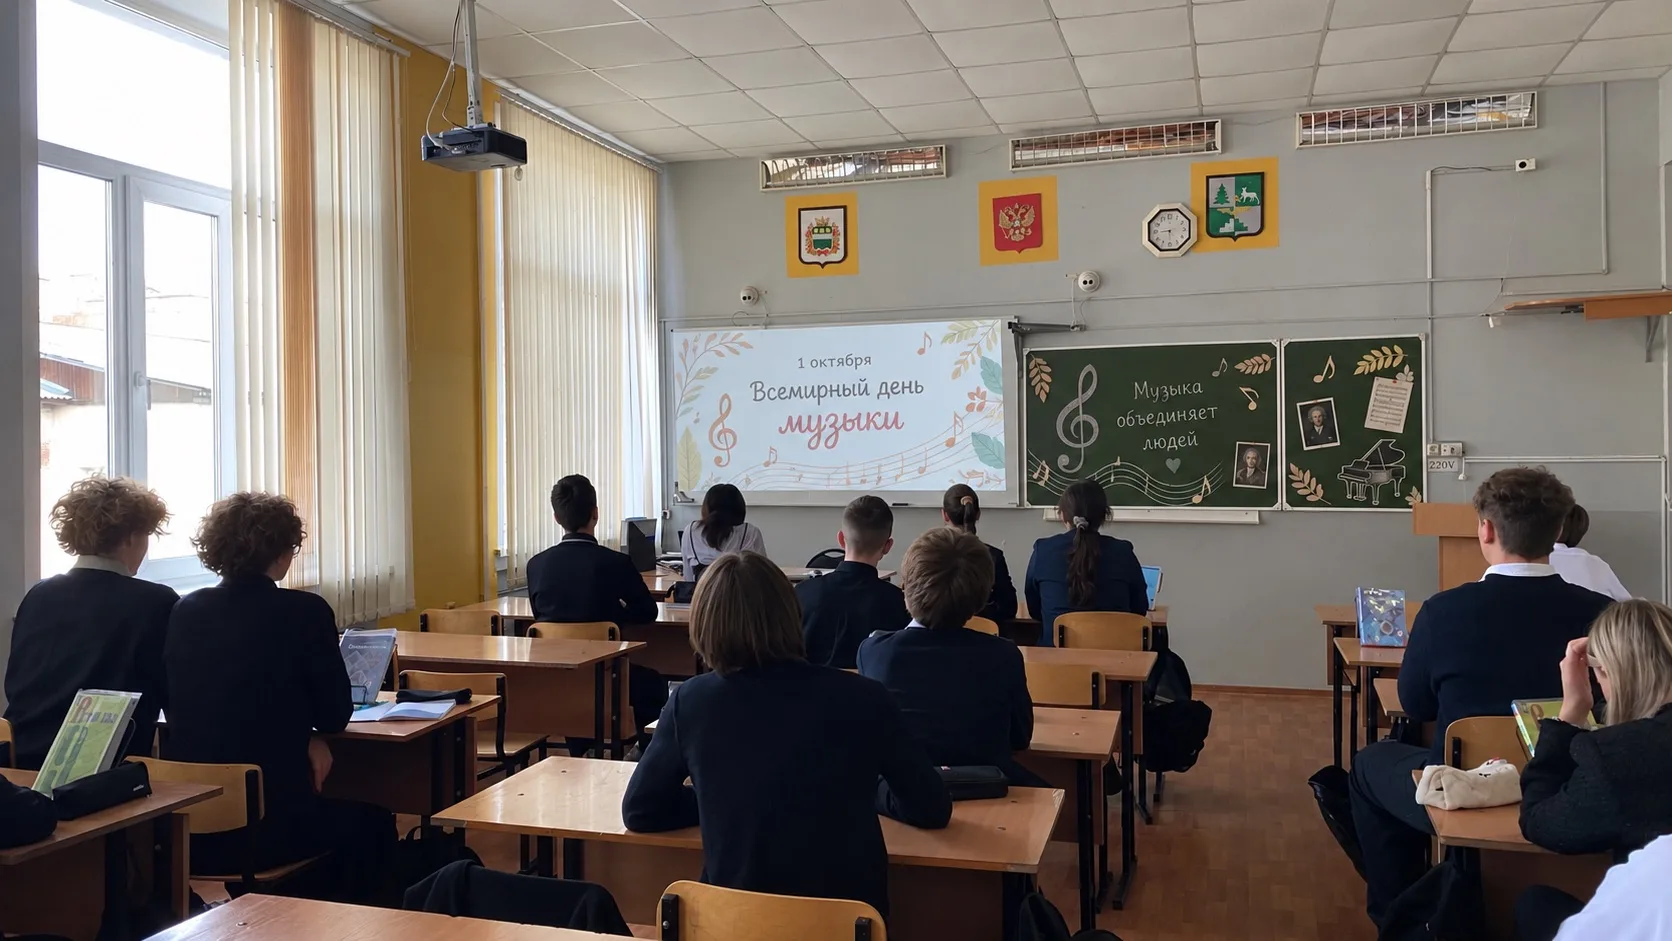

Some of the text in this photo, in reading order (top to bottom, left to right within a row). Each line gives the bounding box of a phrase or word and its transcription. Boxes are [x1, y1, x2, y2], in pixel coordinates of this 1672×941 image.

[797, 353, 872, 370] 1 октября
[749, 378, 924, 405] Всемирный день
[1134, 380, 1204, 402] Музыка
[1116, 405, 1218, 429] объединяет
[778, 411, 904, 450] музыки
[1142, 430, 1199, 451] людей
[1429, 460, 1455, 469] 220V
